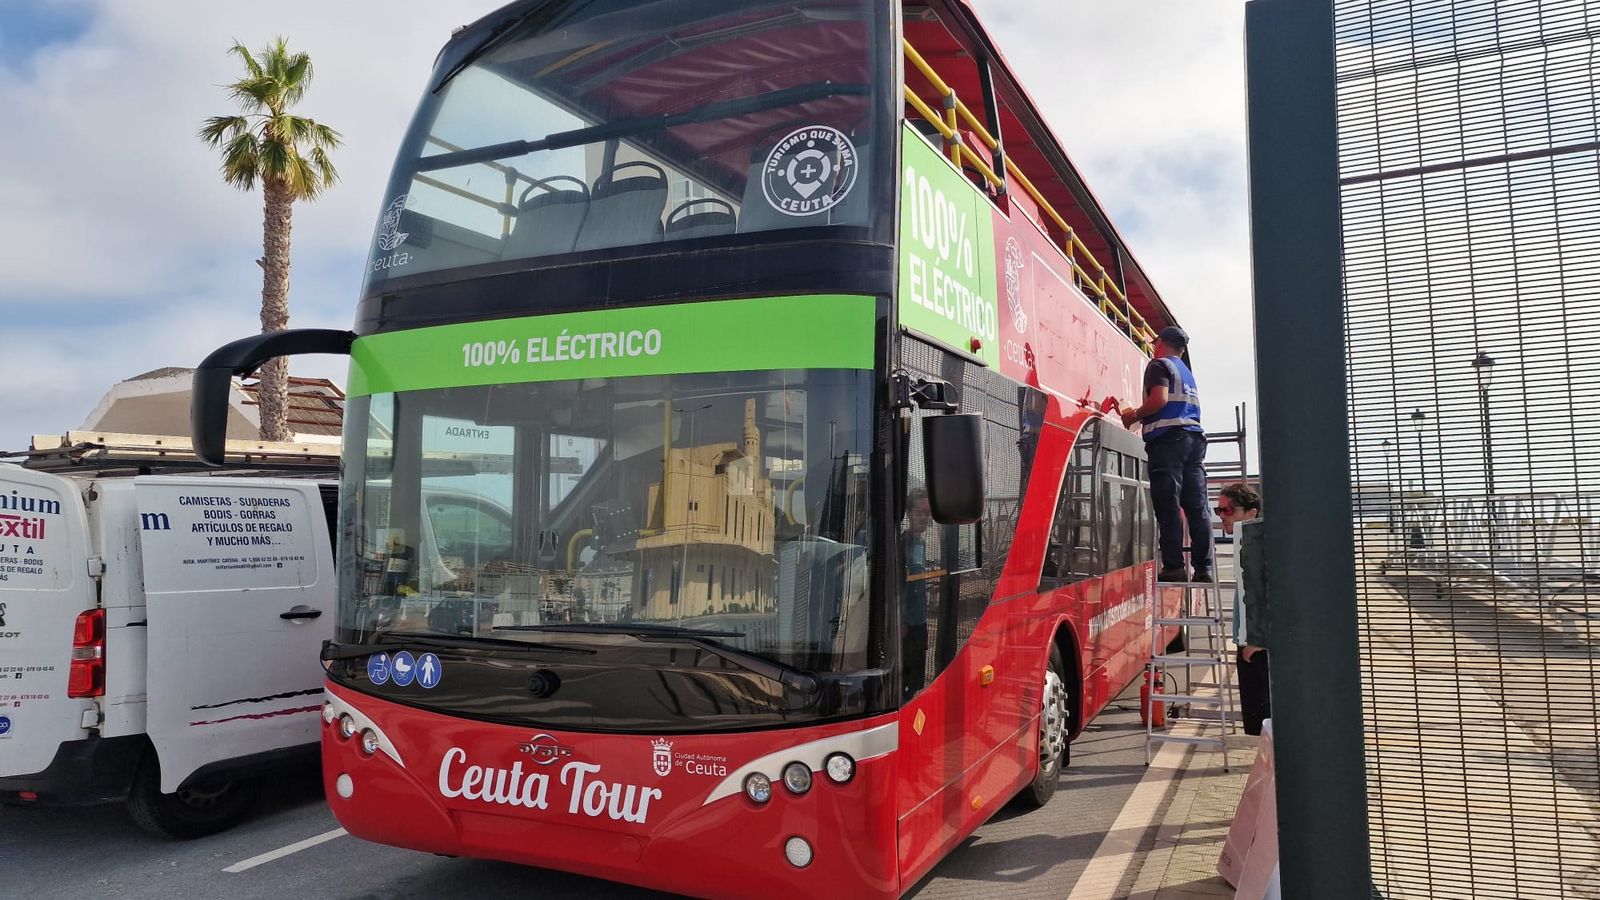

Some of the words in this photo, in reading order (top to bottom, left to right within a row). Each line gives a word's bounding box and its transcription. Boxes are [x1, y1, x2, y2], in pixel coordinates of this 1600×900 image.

[767, 132, 807, 174] TURISMO
[810, 130, 834, 141] QUE
[832, 137, 853, 167] SUMA
[780, 194, 834, 212] CEUTA
[906, 165, 973, 278] 100%
[909, 253, 995, 342] ELÉCTRICO
[462, 339, 520, 367] 100%
[526, 329, 662, 363] ELÉCTRICO
[179, 496, 232, 506] CAMISETAS
[239, 498, 291, 507] SUDADERAS
[140, 512, 171, 530] m
[204, 510, 232, 519] BODIS
[240, 510, 276, 520] GORRAS
[192, 521, 244, 533] ARTÍCULOS
[245, 523, 257, 532] DE
[259, 523, 292, 532] REGALO
[207, 537, 213, 546] Y
[215, 536, 249, 546] MUCHO
[23, 558, 43, 566] BODIS
[17, 566, 43, 575] REGALO
[674, 752, 695, 760] Ciudad
[696, 753, 727, 762] Autónoma
[685, 760, 727, 776] Ceuta
[438, 747, 550, 810] Ceuta
[560, 761, 662, 824] Tour
